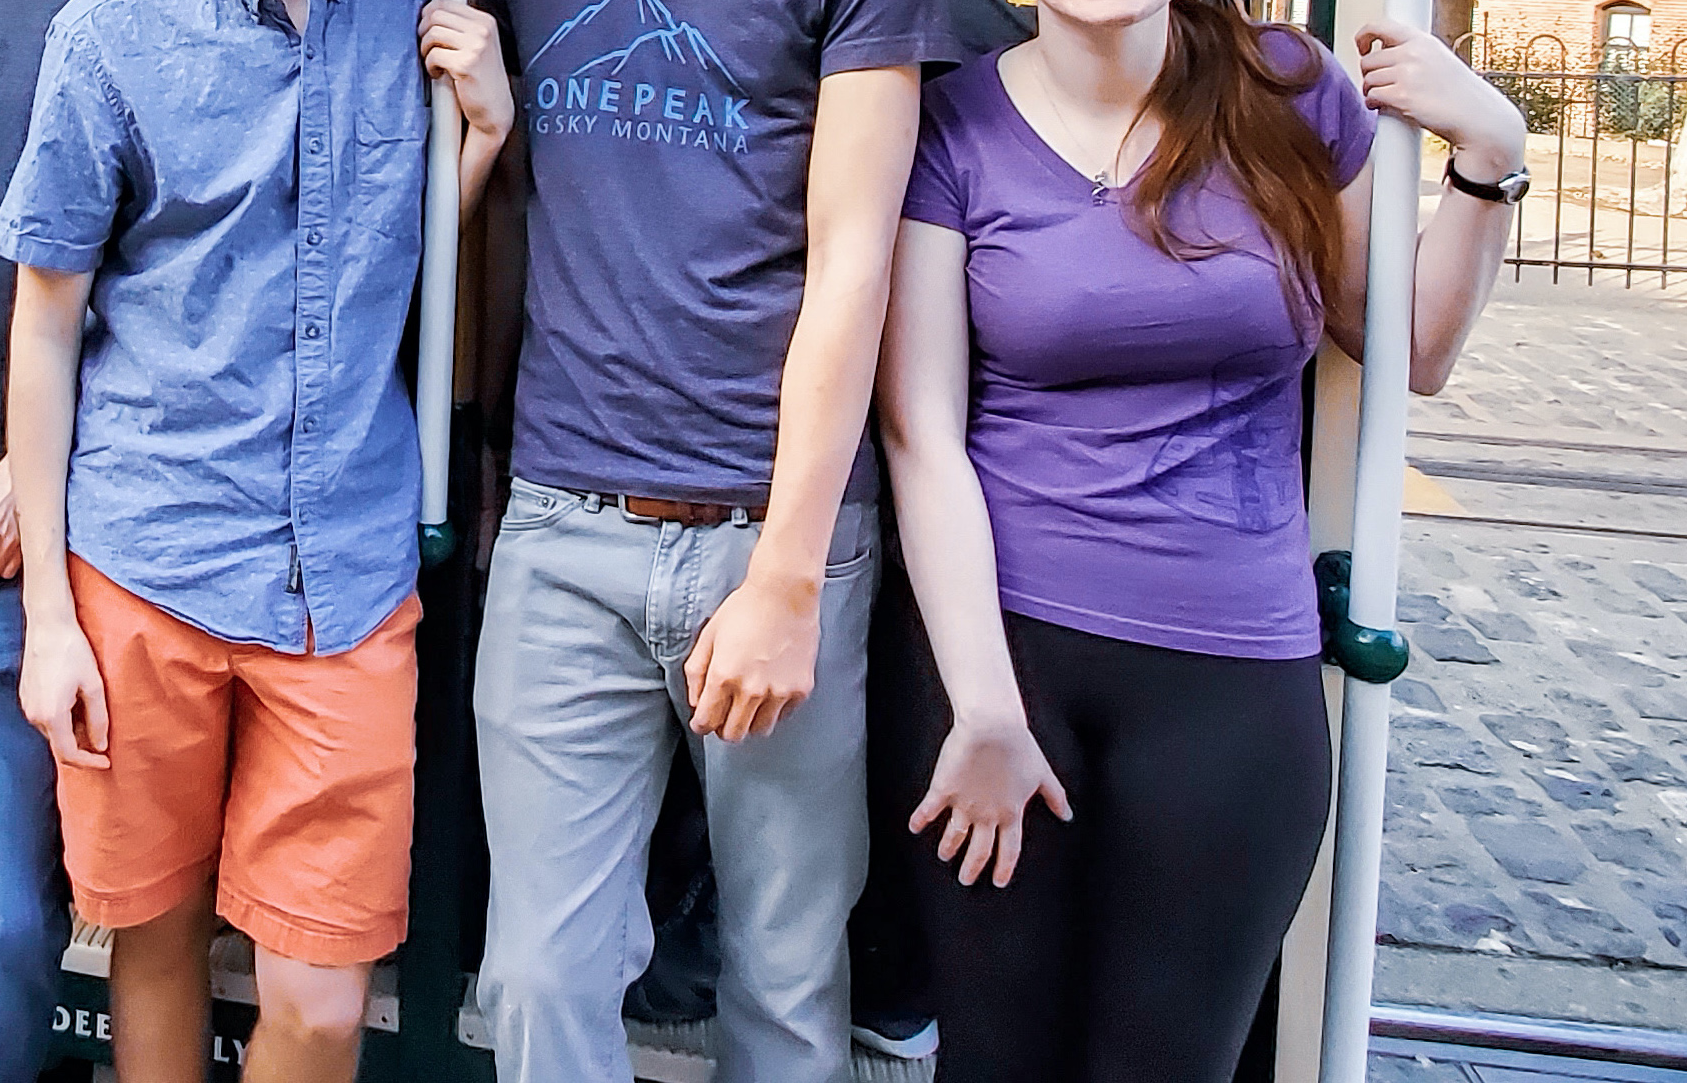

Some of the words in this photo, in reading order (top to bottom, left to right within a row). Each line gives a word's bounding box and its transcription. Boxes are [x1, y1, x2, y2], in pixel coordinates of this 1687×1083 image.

[524, 77, 623, 114] ONE
[634, 82, 751, 130] PEAK
[611, 118, 750, 155] MONTANA
